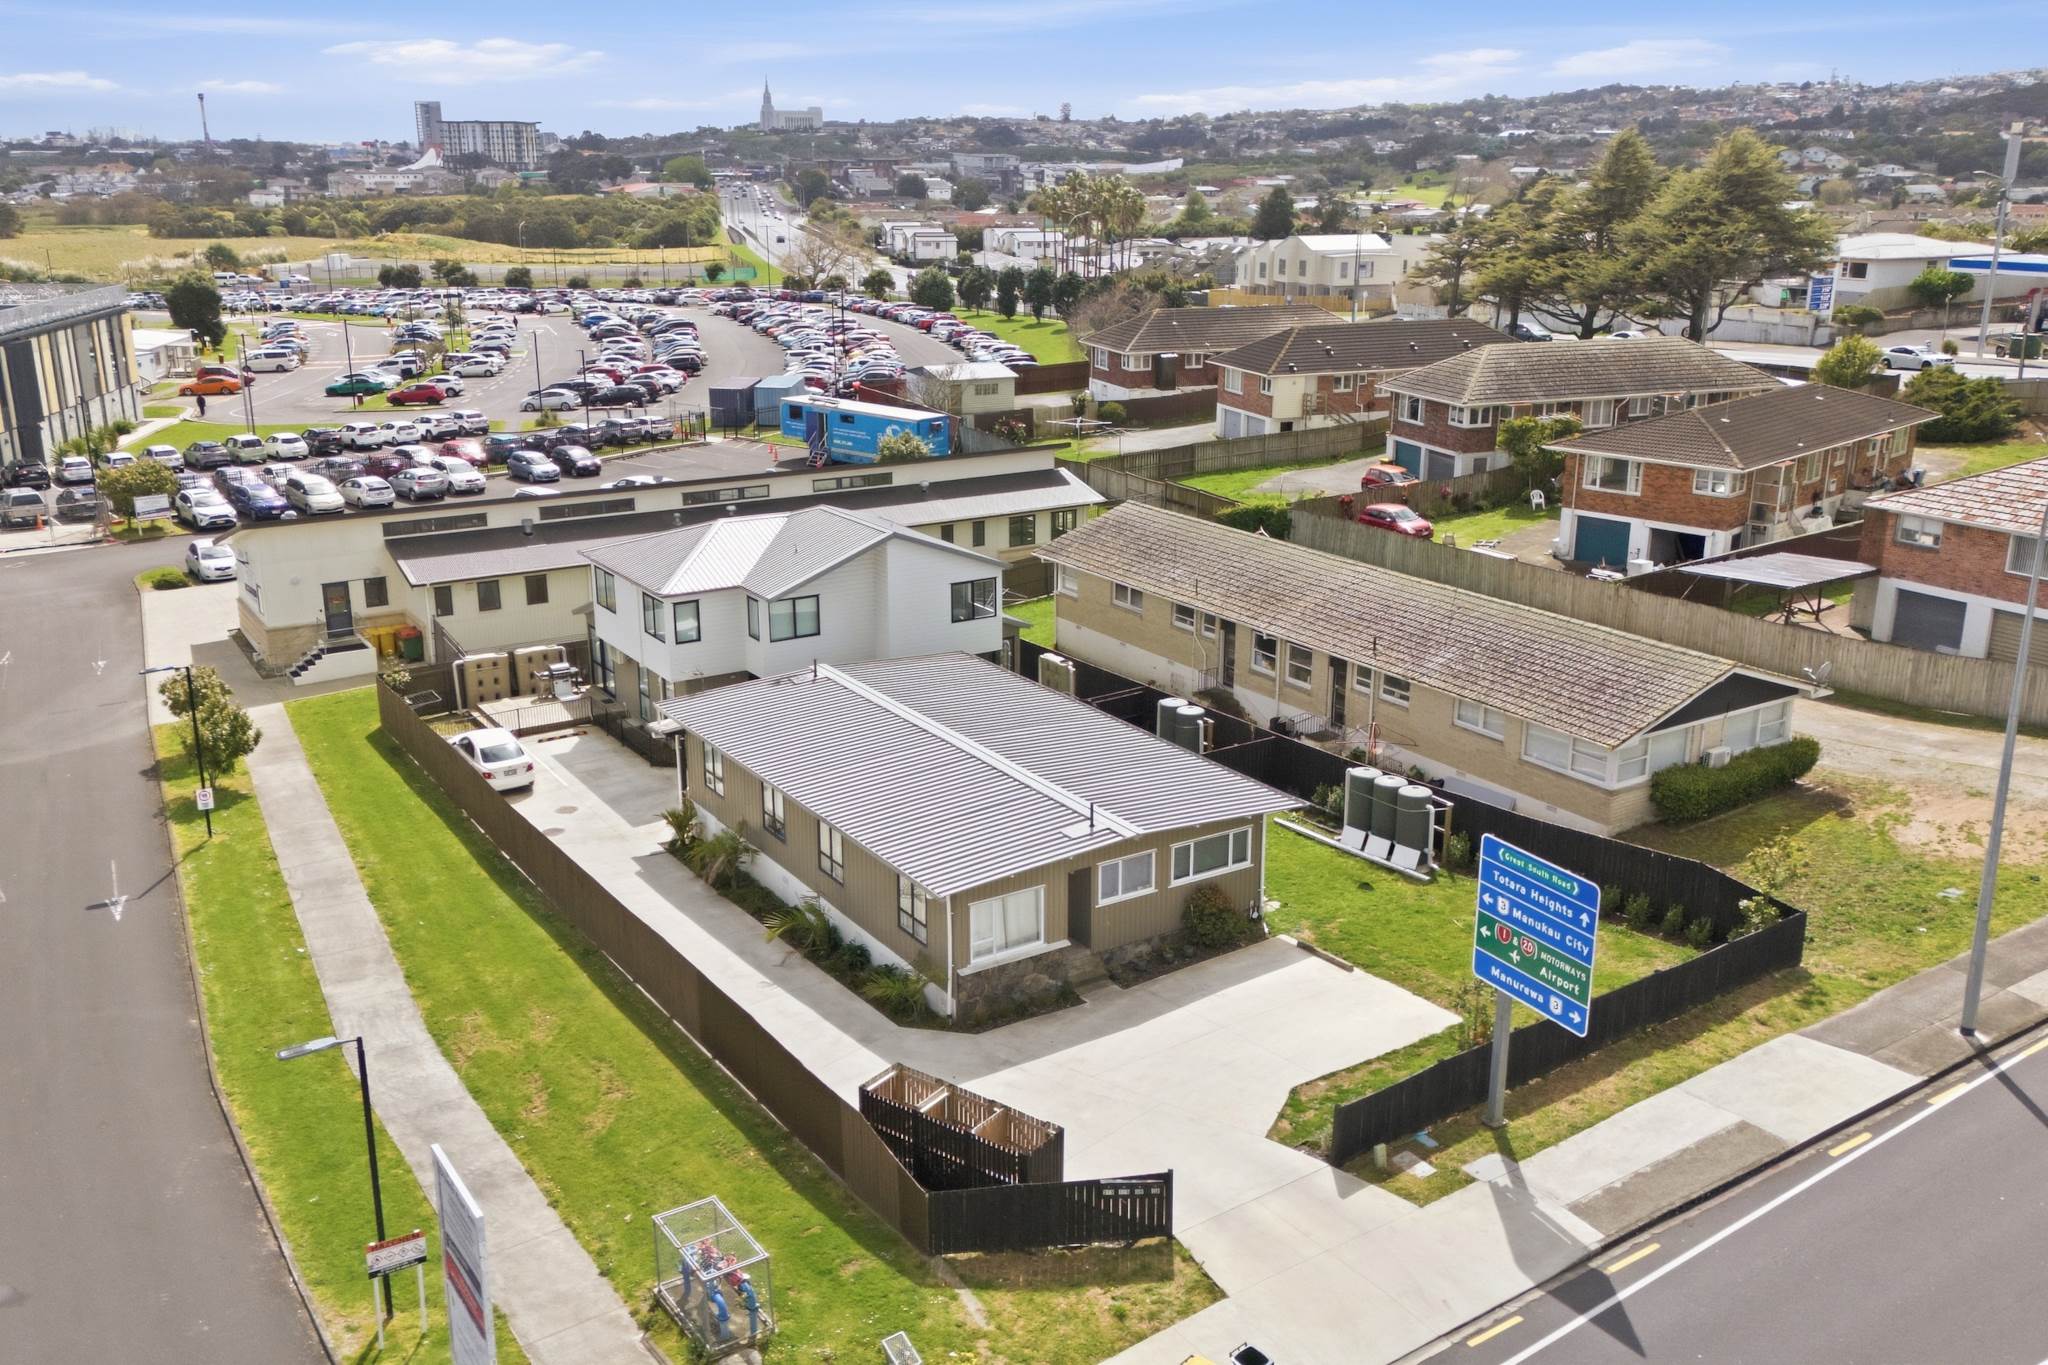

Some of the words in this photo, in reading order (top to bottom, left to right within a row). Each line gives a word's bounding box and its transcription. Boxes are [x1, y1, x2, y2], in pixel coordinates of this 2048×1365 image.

[1505, 852, 1525, 868] Great
[1528, 864, 1550, 879] South
[1552, 875, 1571, 890] Road
[1493, 870, 1526, 895] Totara
[1531, 888, 1573, 918] Heights
[1513, 908, 1560, 940] Manukau
[1566, 935, 1589, 956] City
[1491, 966, 1544, 1003] Manurewa
[1540, 951, 1586, 981] MOTORWAYS
[1540, 967, 1580, 995] Airport
